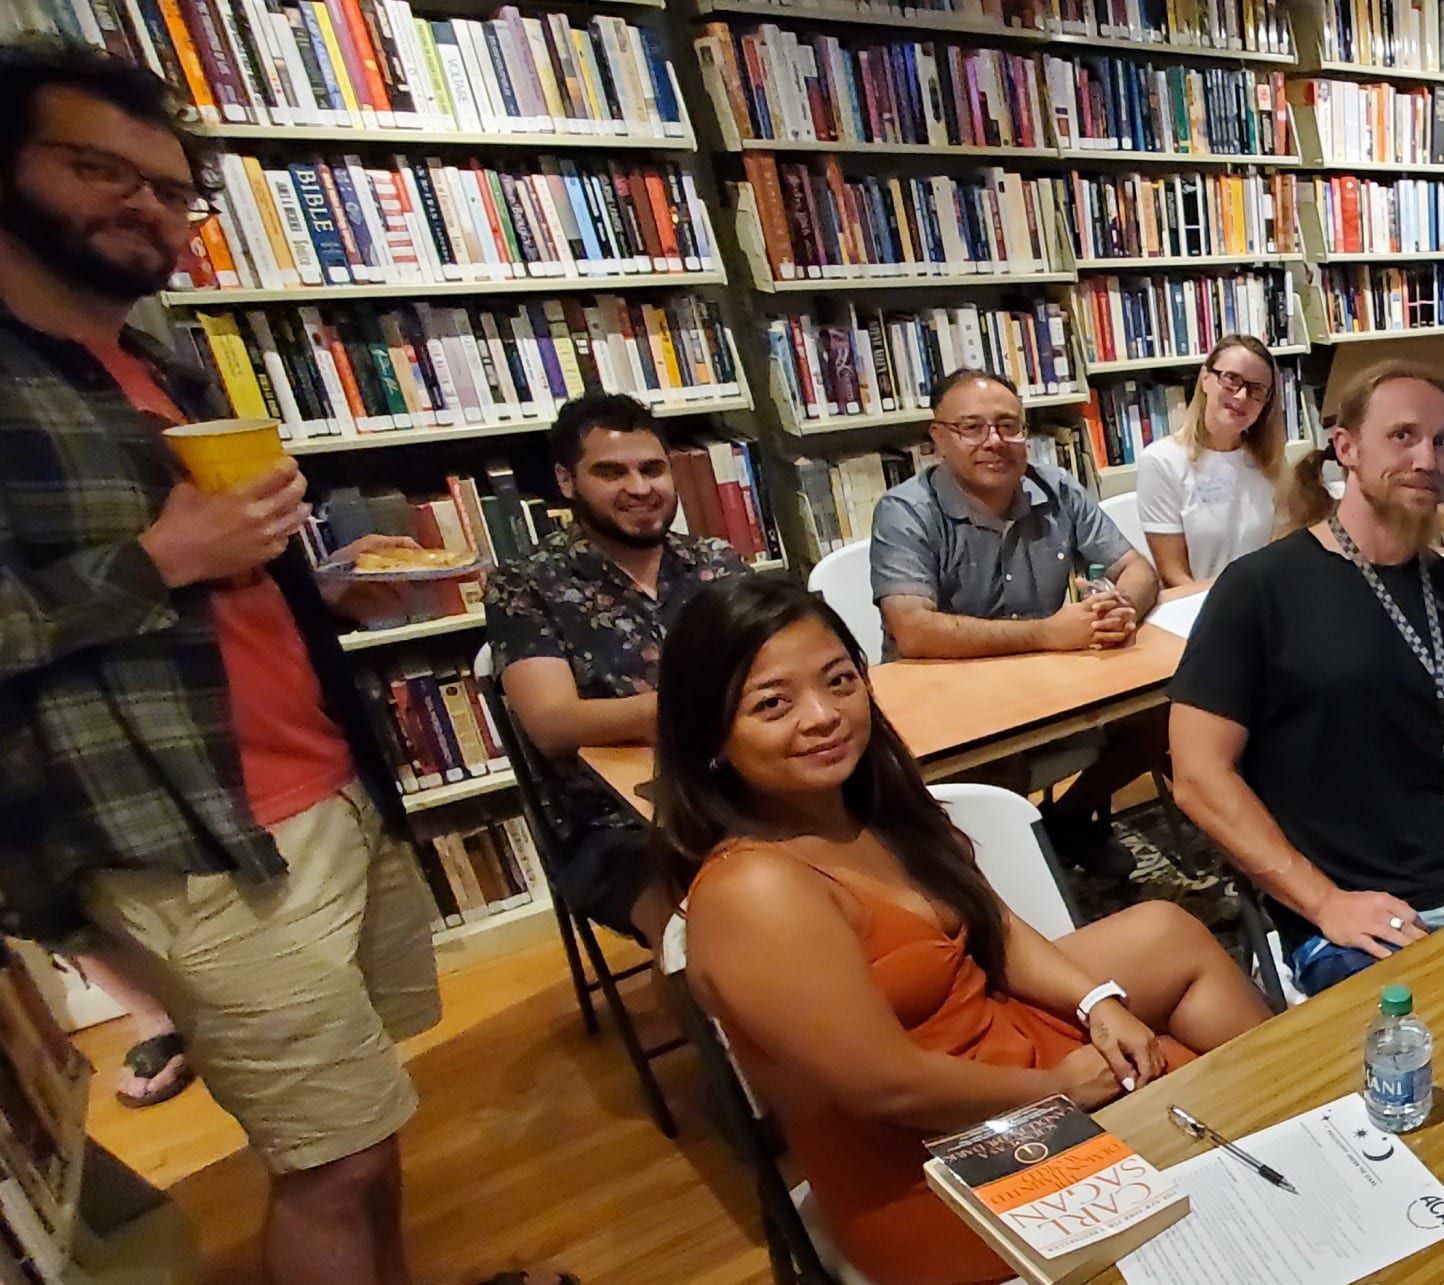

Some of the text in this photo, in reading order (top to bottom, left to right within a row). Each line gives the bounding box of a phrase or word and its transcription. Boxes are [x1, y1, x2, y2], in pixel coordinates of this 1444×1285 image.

[447, 58, 467, 101] VOLTAIRE
[295, 168, 334, 232] BIBLE
[1008, 1158, 1145, 1228] SAGAN
[1036, 1182, 1151, 1234] CARL
